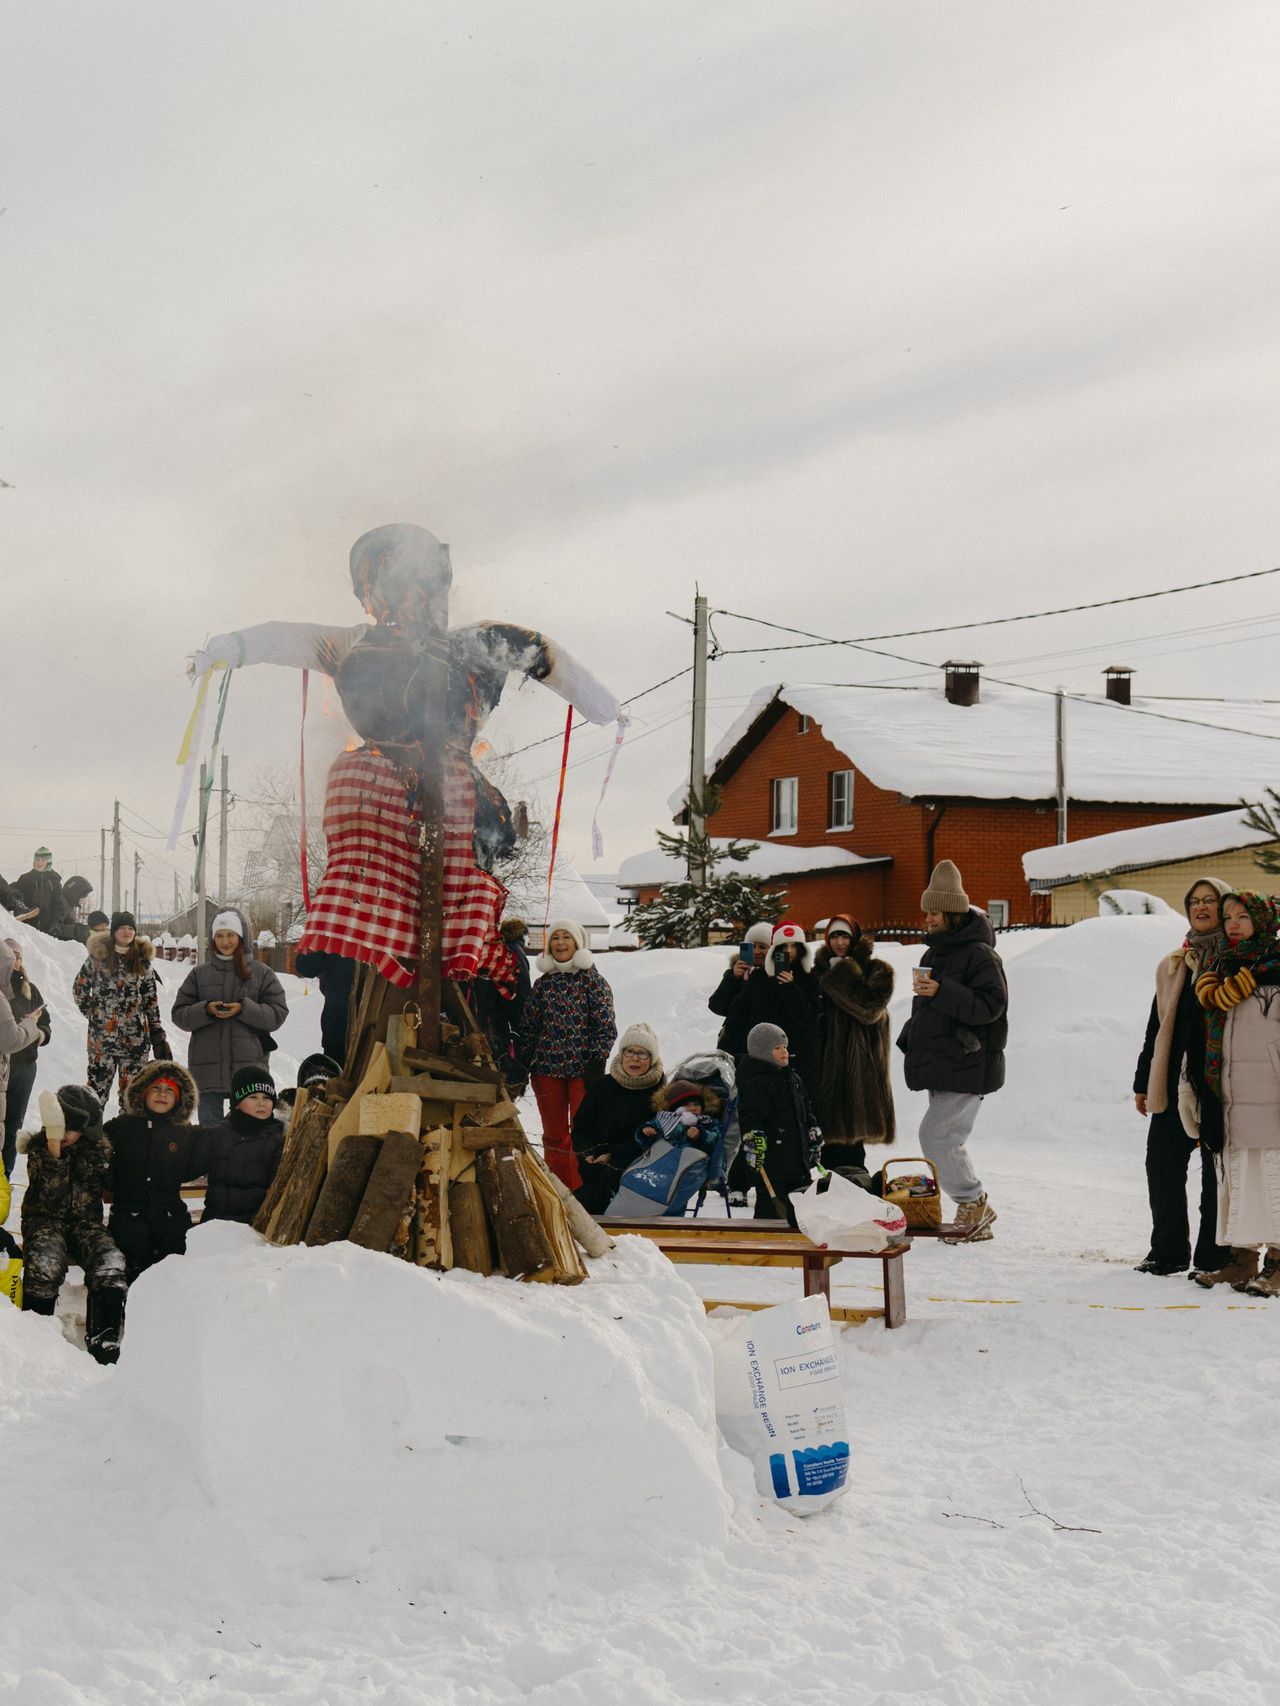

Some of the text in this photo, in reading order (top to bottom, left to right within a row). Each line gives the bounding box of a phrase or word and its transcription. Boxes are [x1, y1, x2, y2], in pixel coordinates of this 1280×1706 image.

[796, 1322, 821, 1335] Canature
[780, 1365, 796, 1375] ION
[799, 1355, 835, 1371] EXCHANGE
[810, 1368, 824, 1376] FOOD
[746, 1340, 777, 1438] ION EXCHANGE RESIN
[747, 1371, 755, 1389] FOOD
